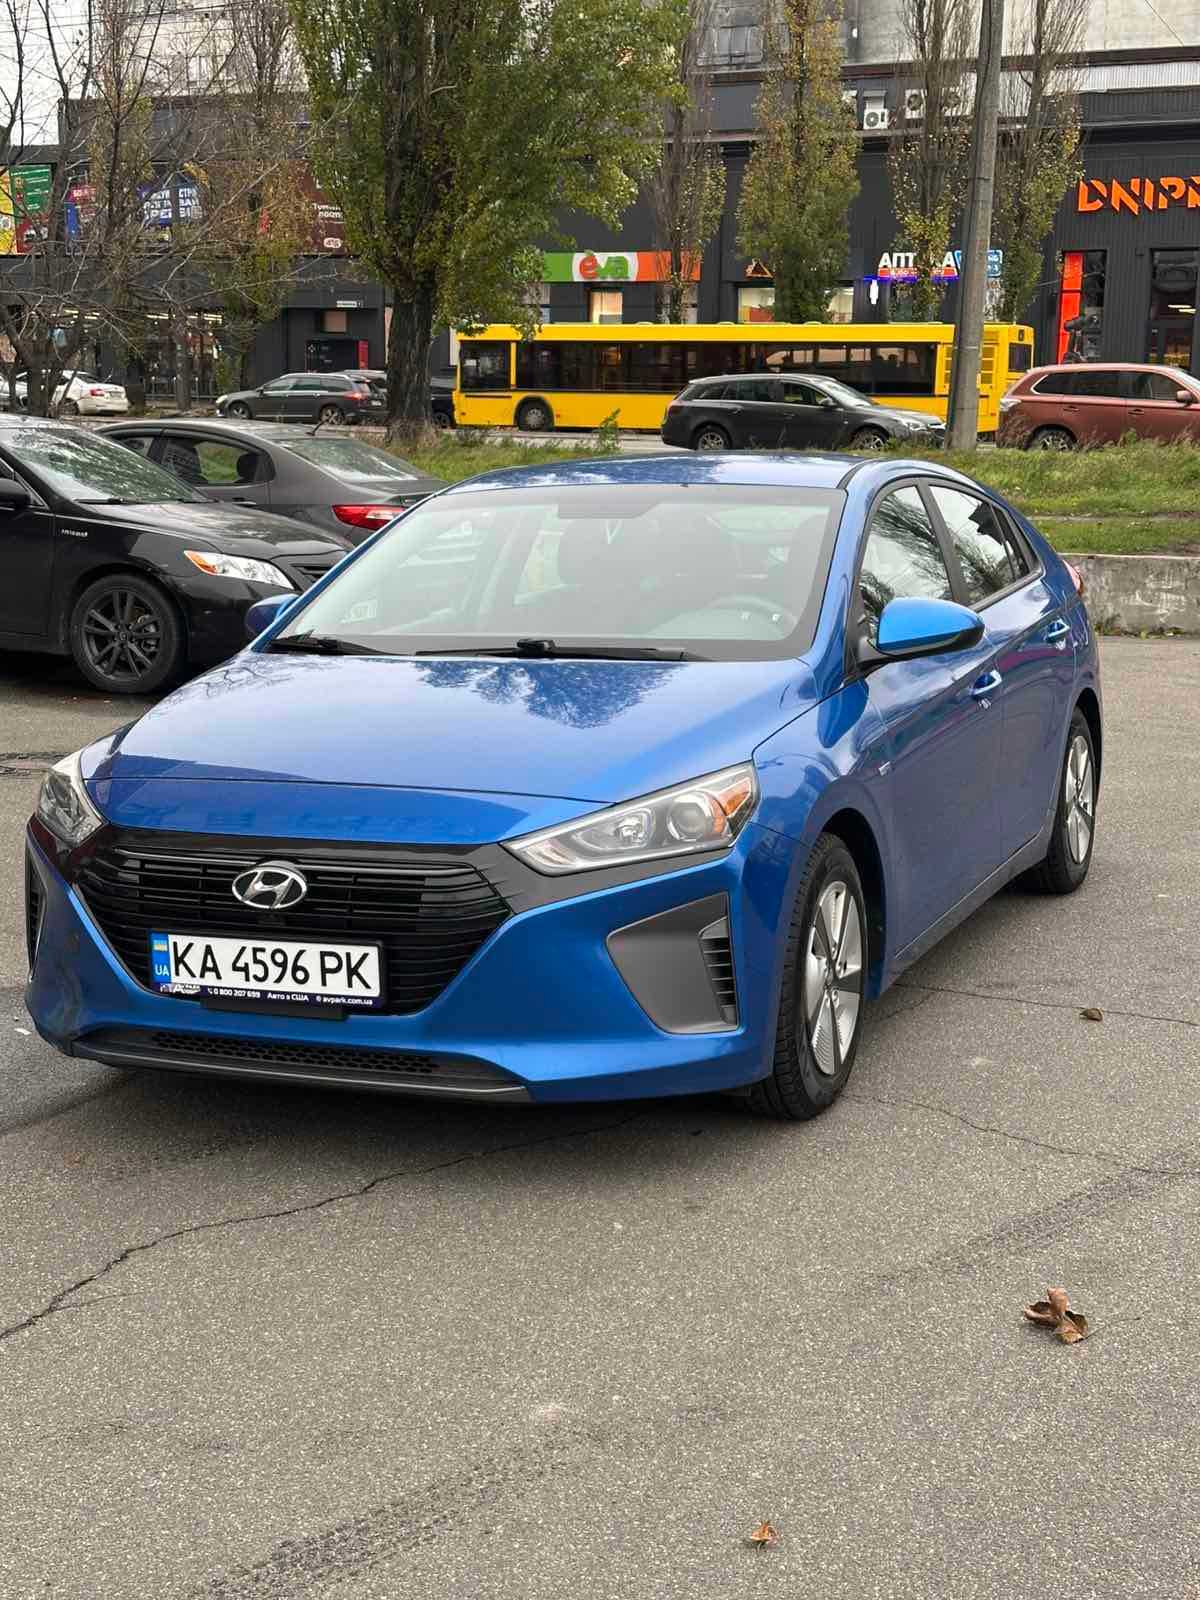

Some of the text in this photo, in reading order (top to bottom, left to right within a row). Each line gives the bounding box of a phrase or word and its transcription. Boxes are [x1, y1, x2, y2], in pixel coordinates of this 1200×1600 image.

[878, 252, 958, 277] АПТА
[154, 964, 170, 977] UA
[173, 941, 372, 990] KA 4596 PK
[219, 988, 233, 996] 800
[291, 993, 310, 1002] США
